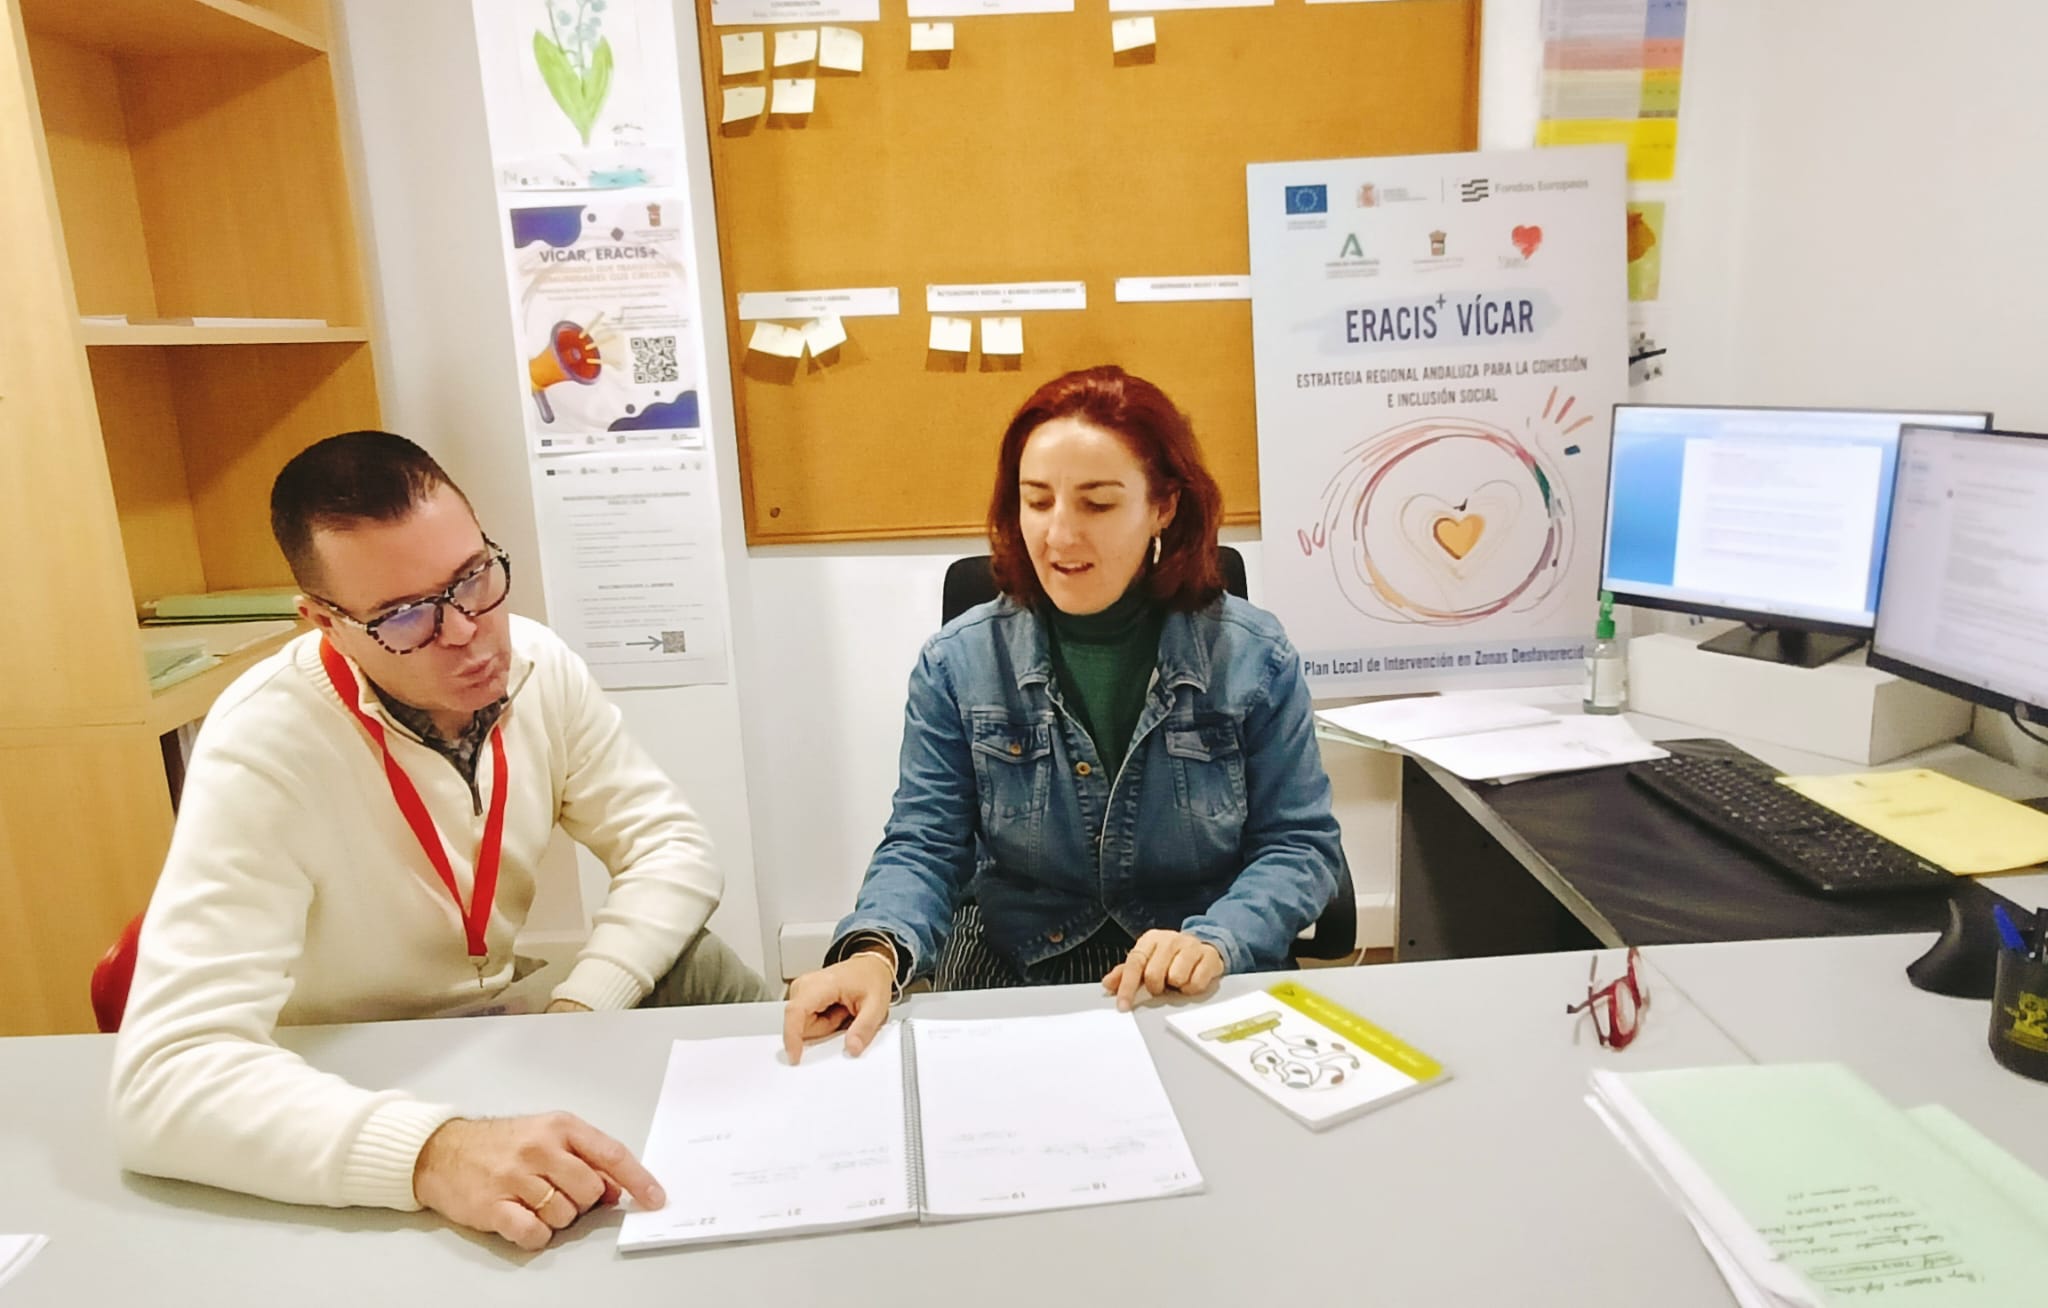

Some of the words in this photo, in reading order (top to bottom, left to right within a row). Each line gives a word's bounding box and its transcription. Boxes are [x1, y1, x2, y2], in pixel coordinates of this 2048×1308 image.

[1456, 294, 1534, 336] VÍCAR
[1296, 371, 1363, 388] ESTRATEGIA
[1365, 367, 1419, 384] REGIONAL
[1422, 363, 1479, 381] ANDALUZA
[1483, 361, 1512, 377] PARA
[1516, 360, 1528, 375] LA
[1532, 355, 1588, 374] COHESIÓN
[1387, 393, 1394, 408] E
[1397, 387, 1456, 407] INCLUSIÓN
[1460, 388, 1498, 404] SOCIAL
[1304, 660, 1329, 676] Plan
[1333, 658, 1362, 674] Local
[1367, 657, 1381, 672] de
[1384, 651, 1454, 671] Intervención
[1457, 654, 1471, 667] en
[1475, 650, 1508, 666] Zonas
